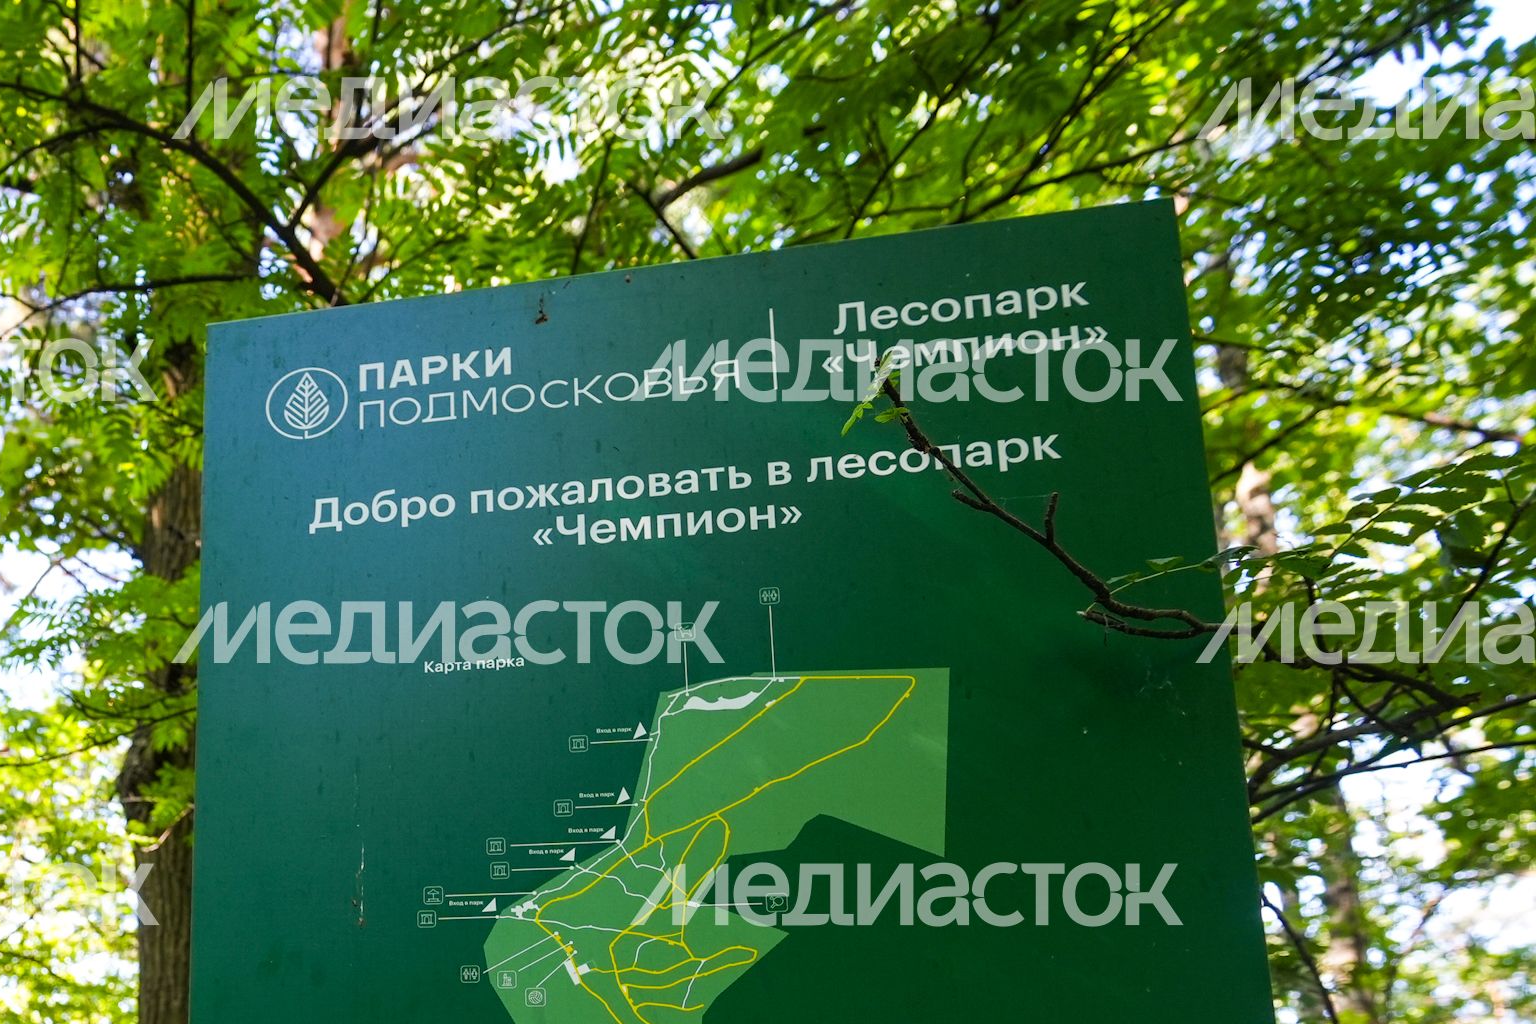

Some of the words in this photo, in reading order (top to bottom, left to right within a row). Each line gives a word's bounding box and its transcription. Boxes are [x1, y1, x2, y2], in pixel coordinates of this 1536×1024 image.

[833, 281, 1089, 335] Лесопарк
[359, 346, 512, 392] ПАРКИ
[359, 359, 741, 430] ПОДМОСКОВЬЯ
[308, 488, 456, 534] Добро
[470, 465, 752, 514] пожаловать
[767, 461, 792, 486] в
[806, 434, 1061, 483] лесопарк
[532, 504, 802, 546] «Чемпион»
[424, 661, 471, 674] Карта
[476, 657, 524, 670] парка
